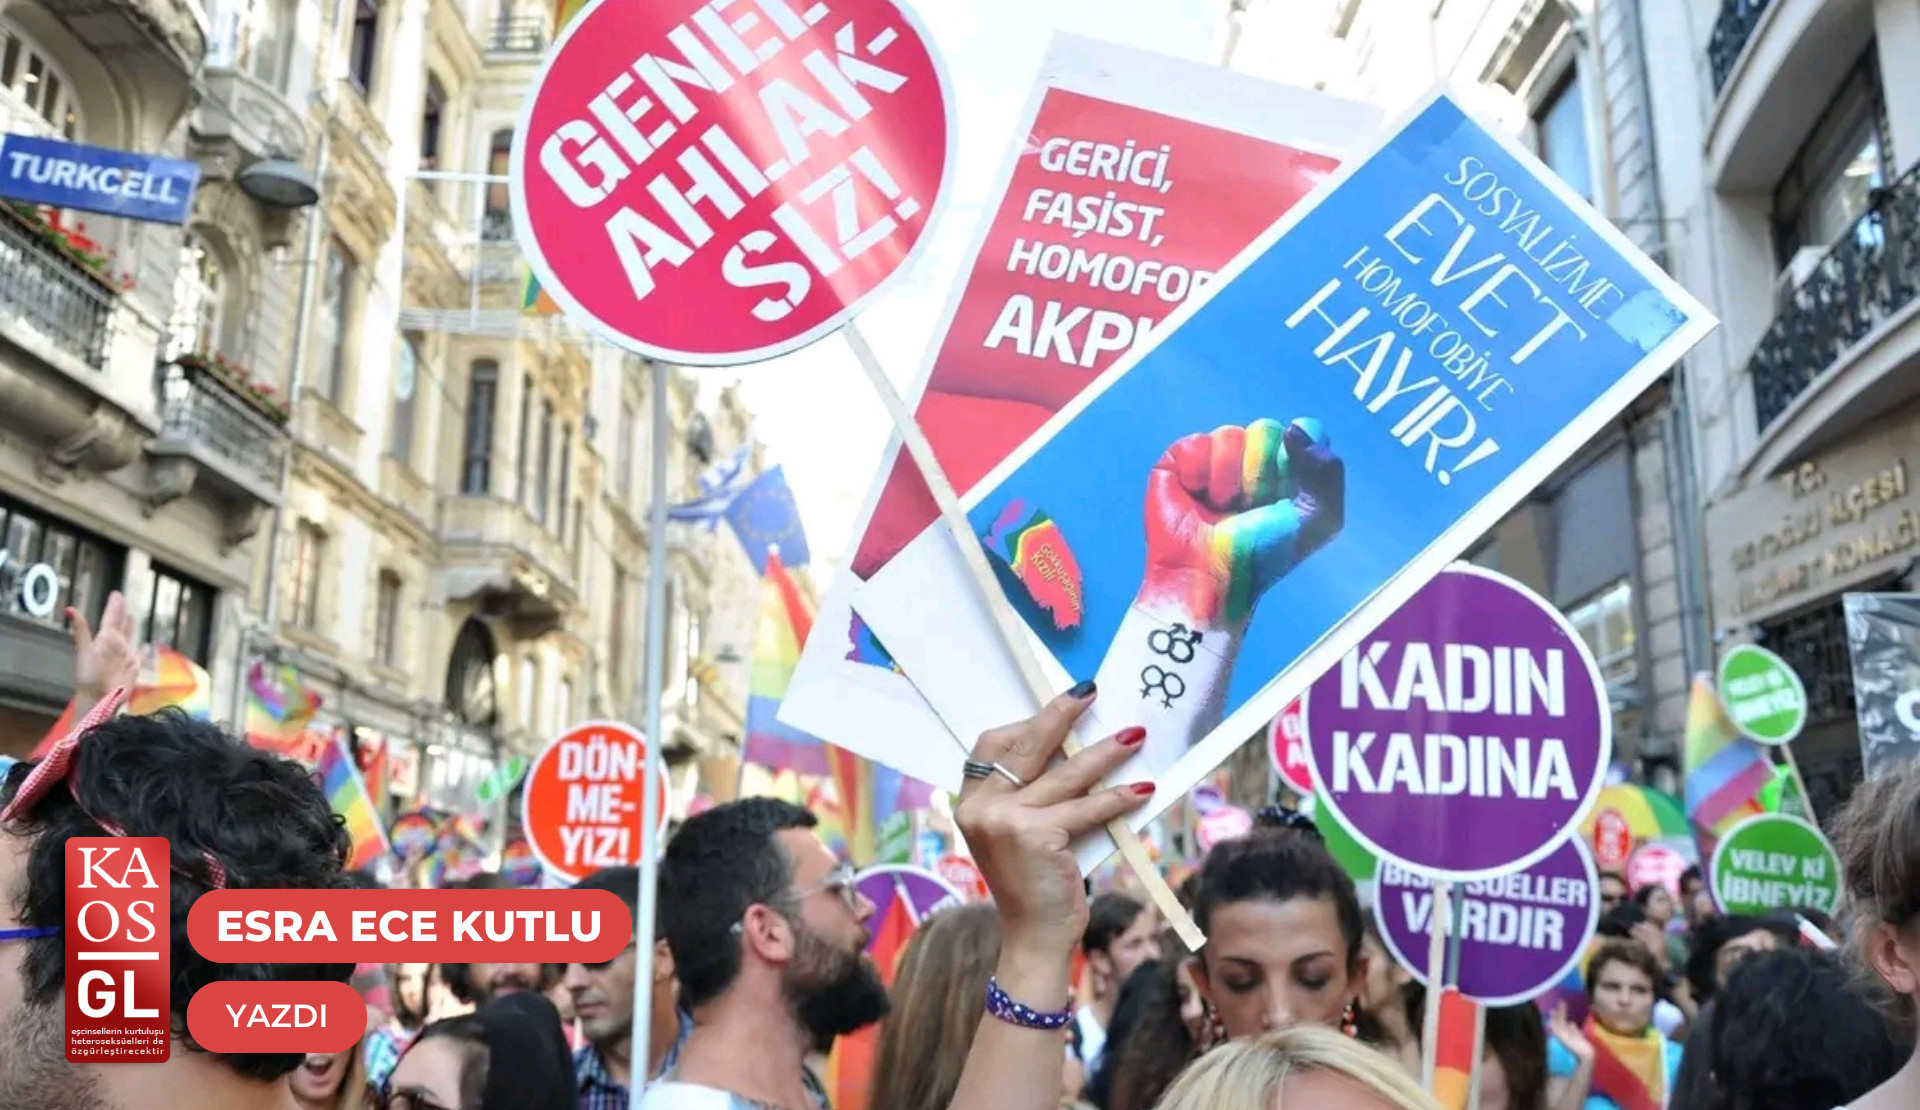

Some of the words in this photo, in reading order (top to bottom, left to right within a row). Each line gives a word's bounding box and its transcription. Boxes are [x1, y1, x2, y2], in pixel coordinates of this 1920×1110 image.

[540, 0, 830, 208] GENEL
[9, 151, 178, 205] TURKCELL
[604, 20, 909, 301] AHLAK-
[1039, 137, 1174, 194] GERİCİ,
[721, 145, 921, 322] SIZ!
[1022, 188, 1165, 248] FAŞİST,
[1444, 156, 1625, 320] SOSYALİZME
[1384, 192, 1588, 365] EVET
[1342, 245, 1515, 412] HOMOFOBİYE
[1285, 277, 1500, 486] HAYIR!
[1340, 641, 1565, 717] KADIN
[558, 735, 648, 783] DÖN-
[1332, 731, 1579, 801] KADINA
[566, 783, 636, 824] ME-
[558, 826, 631, 867] YİZ!
[1729, 848, 1797, 876] VELEV
[1402, 891, 1565, 951] VARDIR
